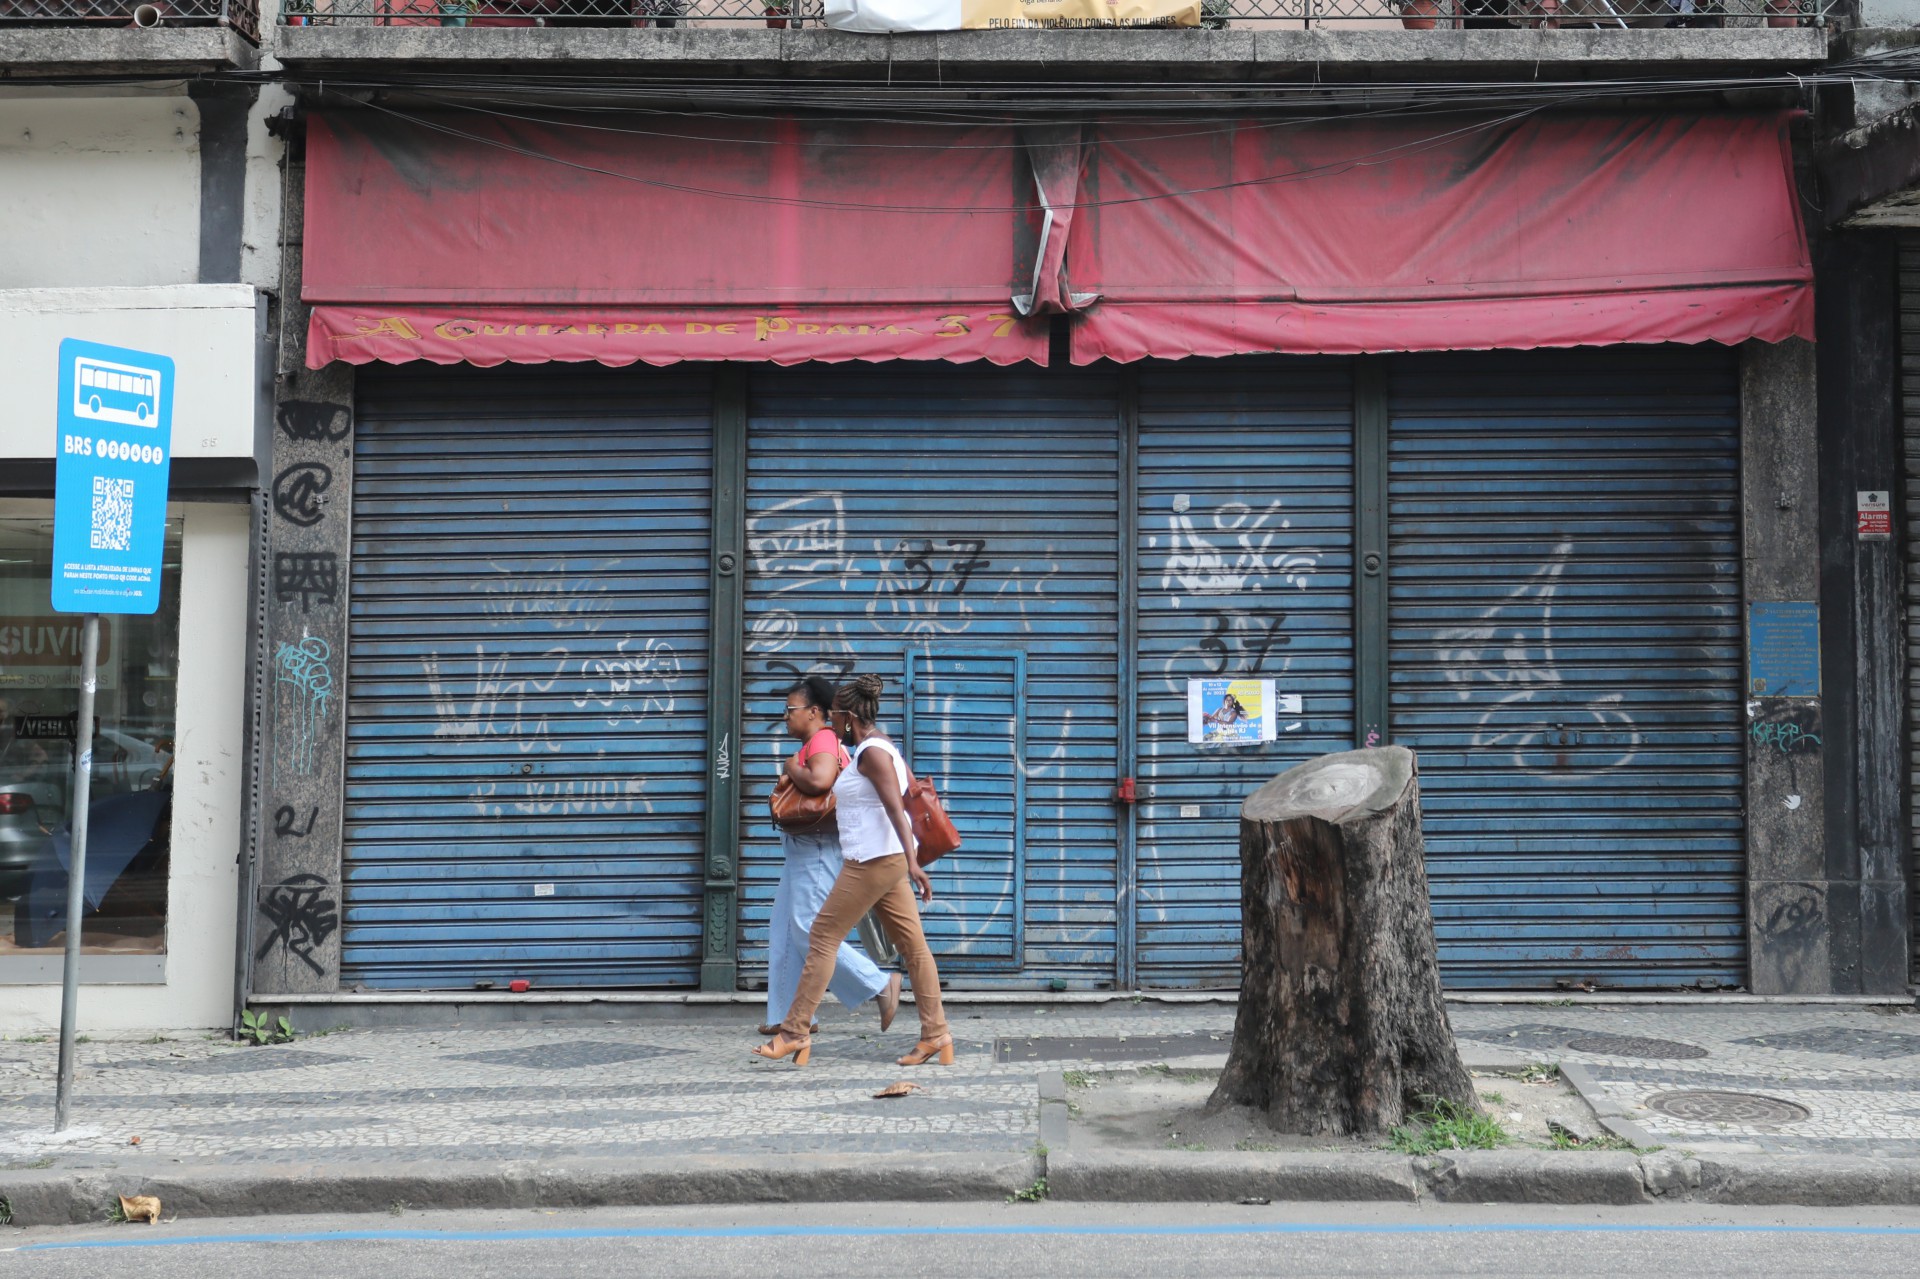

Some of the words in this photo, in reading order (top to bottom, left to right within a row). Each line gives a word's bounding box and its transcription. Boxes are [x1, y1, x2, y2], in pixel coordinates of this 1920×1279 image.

[989, 18, 1009, 29] PELO
[1011, 18, 1025, 29] FIM
[1028, 18, 1039, 29] DA
[1041, 15, 1082, 29] VIOLÊNCIA
[1085, 18, 1116, 29] CONTRA
[1120, 18, 1130, 28] AS
[1132, 16, 1176, 27] MULHERES
[328, 316, 422, 340] A
[685, 322, 738, 335] DE
[754, 316, 923, 341] PRATA
[935, 313, 1018, 338] 37
[64, 434, 92, 456] BRS
[1860, 512, 1888, 520] Alarme
[63, 571, 79, 579] PARAM
[92, 572, 108, 580] PONTO
[97, 564, 122, 572] ATUALIZADA
[142, 567, 152, 575] QUE
[1196, 613, 1291, 675] 37
